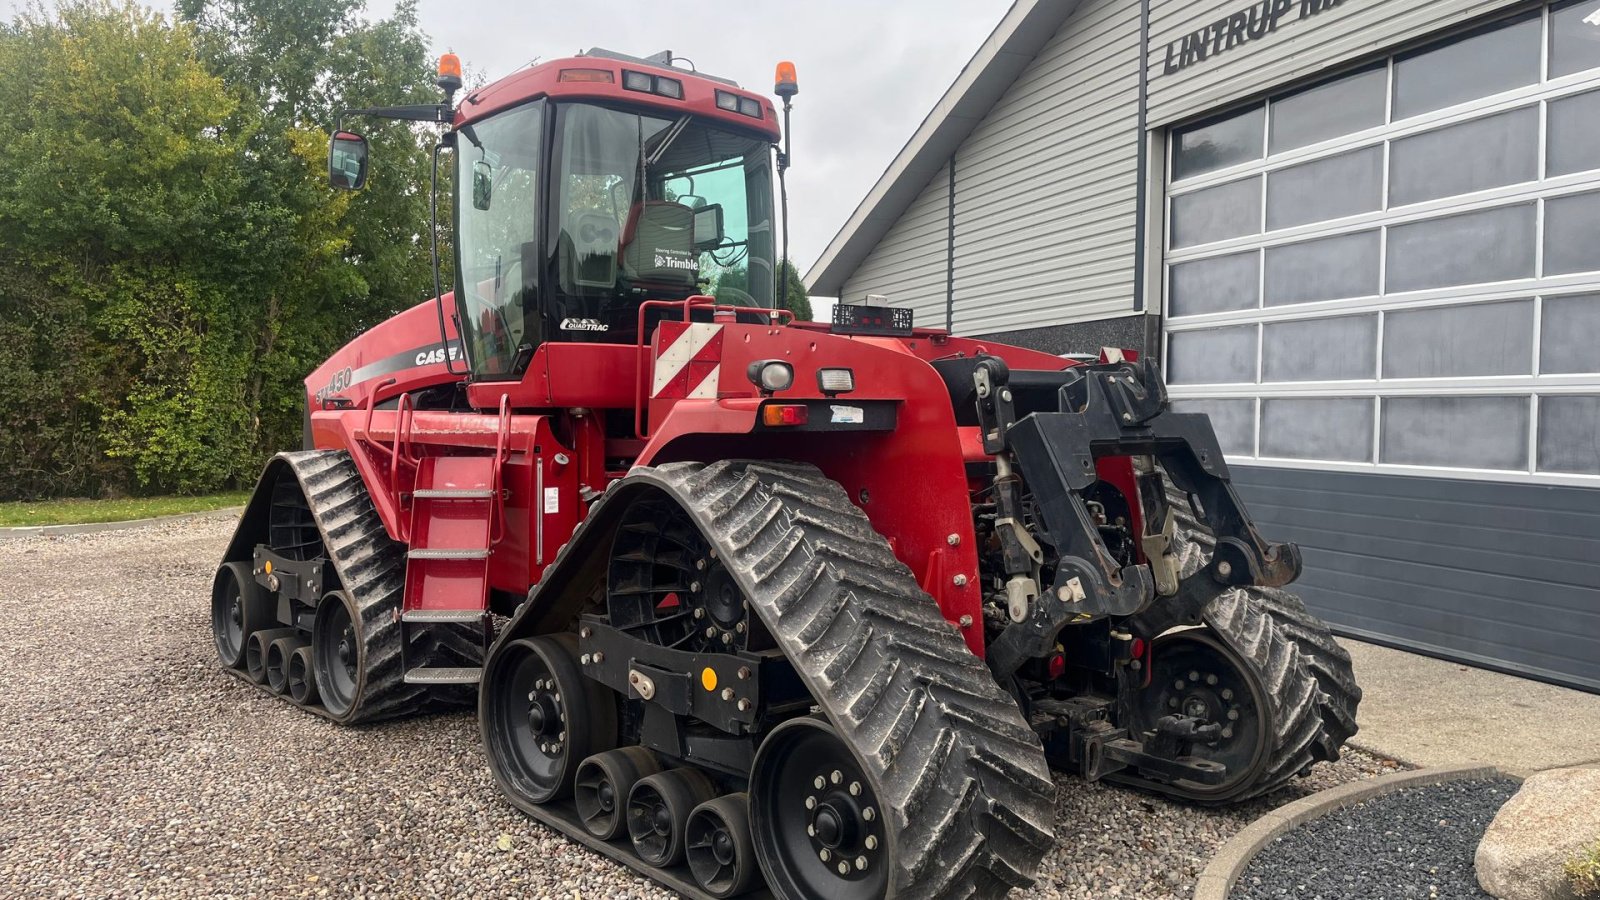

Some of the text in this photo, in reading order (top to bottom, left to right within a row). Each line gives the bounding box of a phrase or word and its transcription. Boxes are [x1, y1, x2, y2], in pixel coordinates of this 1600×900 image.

[1163, 0, 1292, 76] LINTRUP
[665, 256, 699, 271] Trimble
[415, 346, 458, 366] CASE
